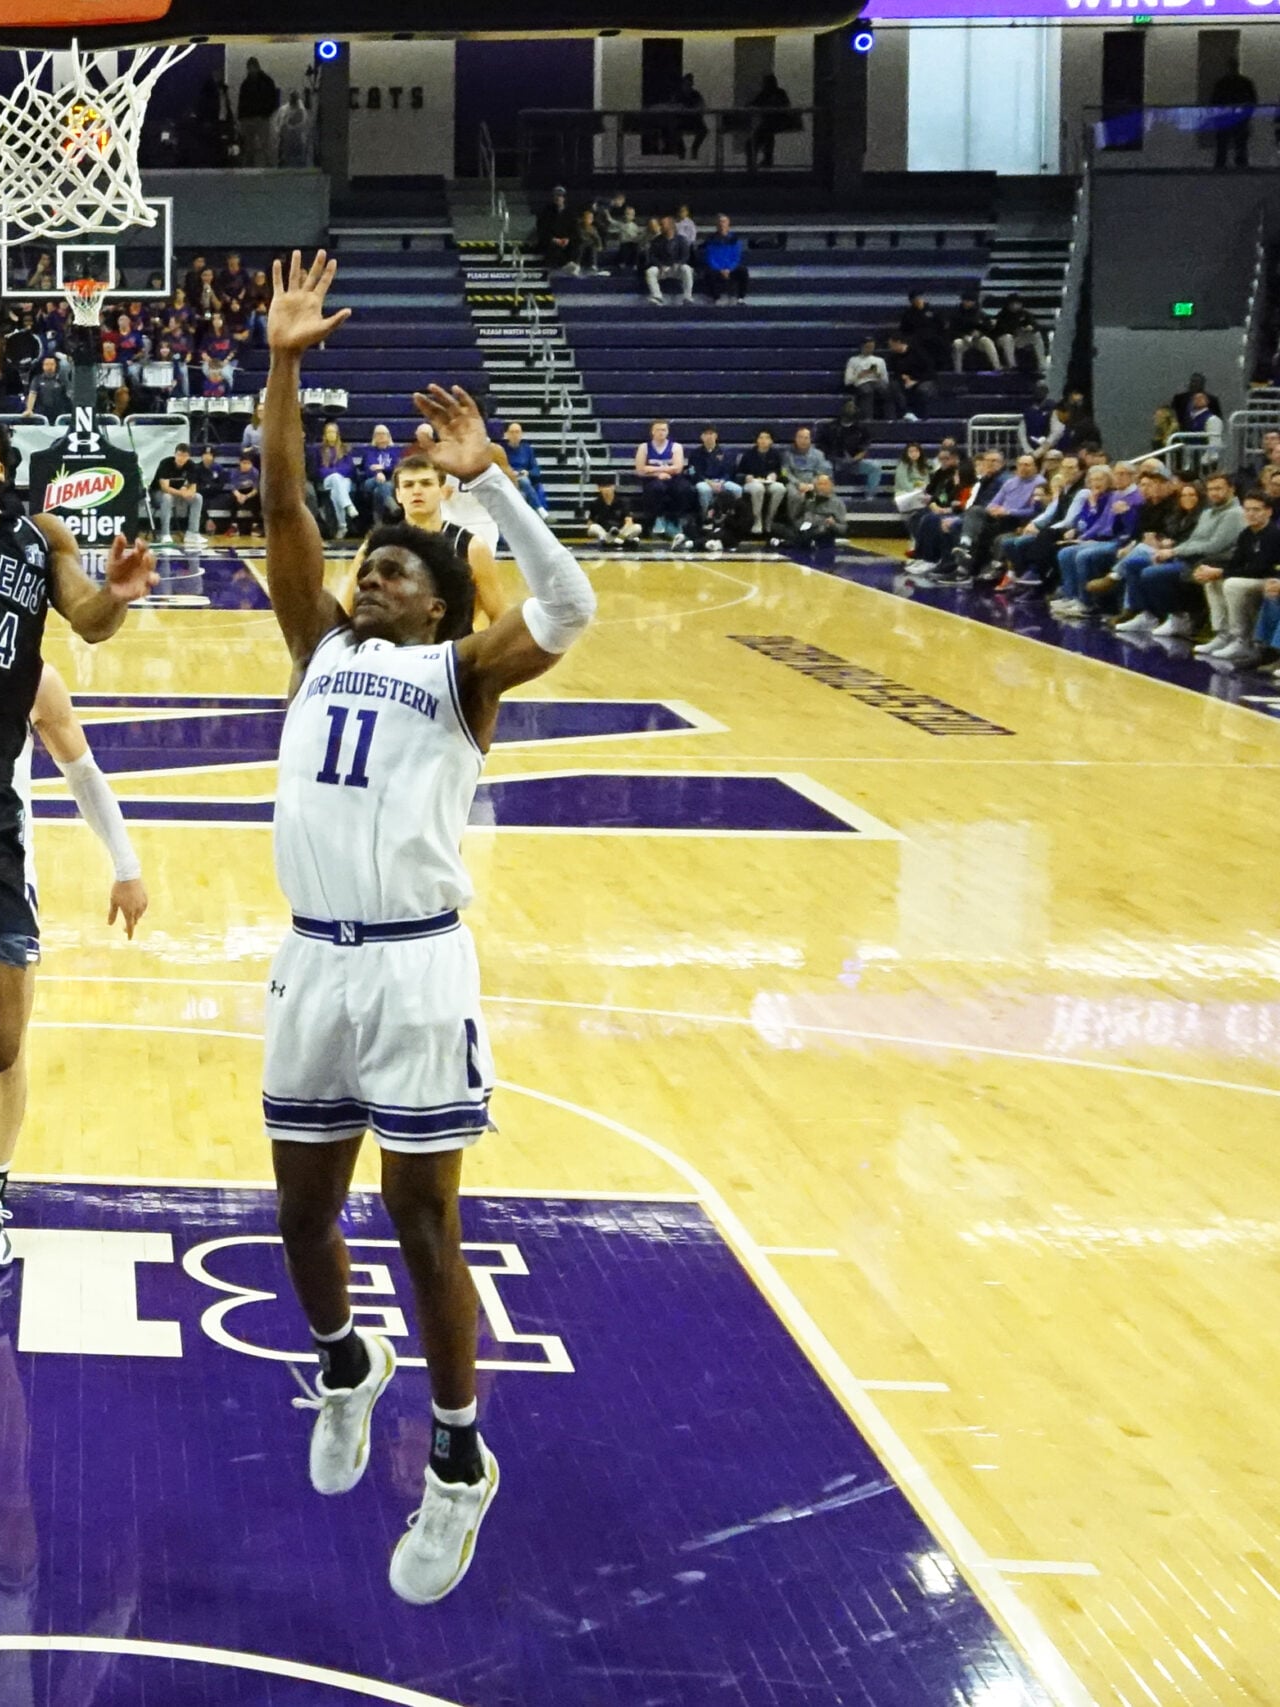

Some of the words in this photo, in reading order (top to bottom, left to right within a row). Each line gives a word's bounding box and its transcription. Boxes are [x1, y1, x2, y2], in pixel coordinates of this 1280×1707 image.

[75, 407, 93, 433] N
[42, 473, 118, 512] LIBMAN
[61, 509, 126, 543] eijer
[316, 704, 379, 788] 11
[340, 921, 356, 943] N
